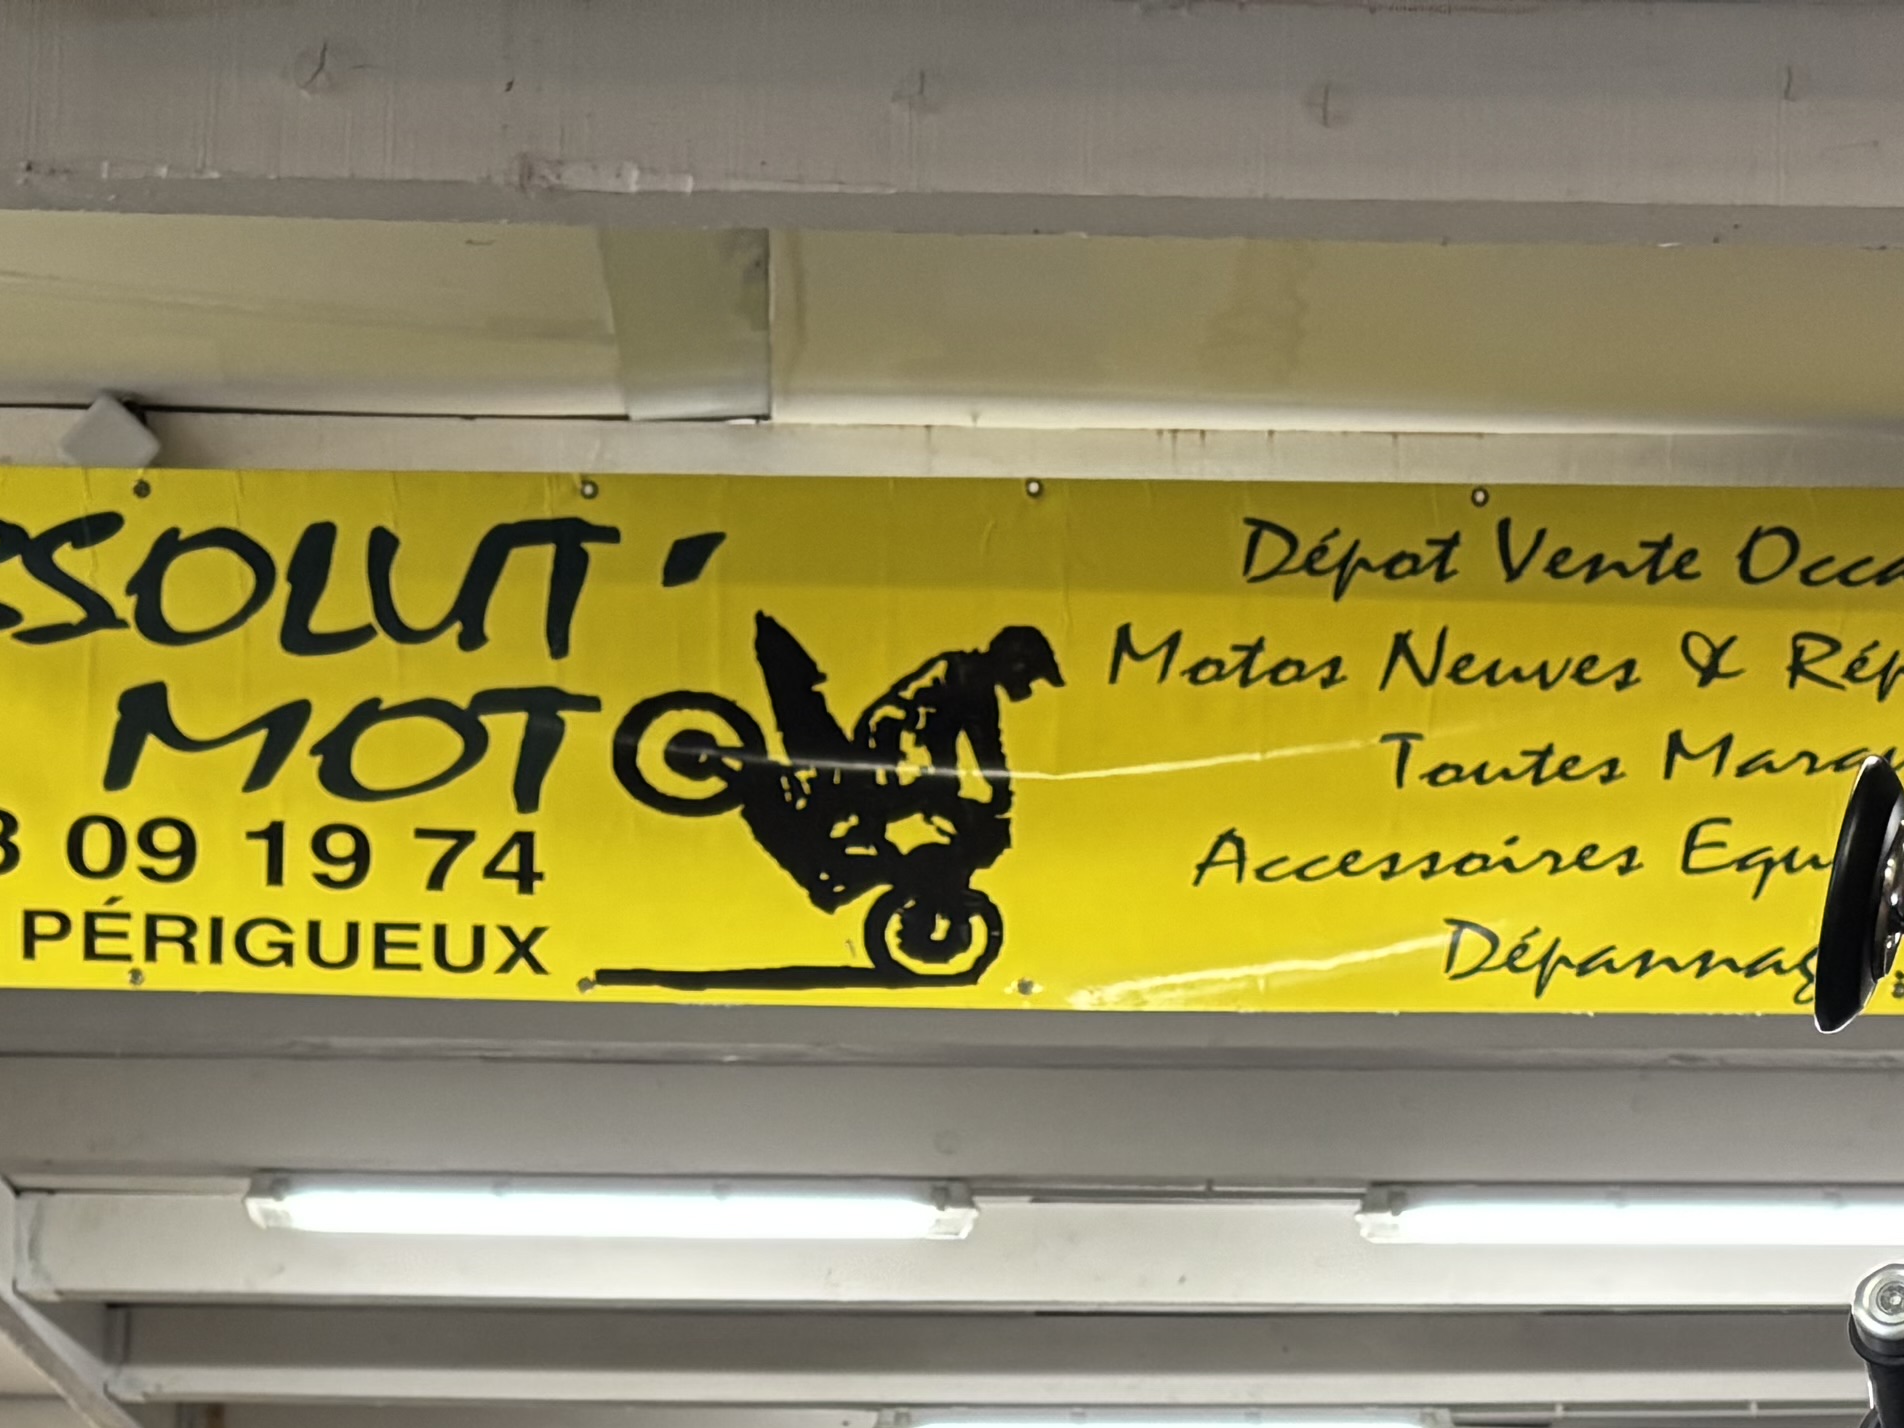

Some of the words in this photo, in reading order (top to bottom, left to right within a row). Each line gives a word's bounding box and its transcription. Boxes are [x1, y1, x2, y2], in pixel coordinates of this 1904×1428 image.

[1497, 518, 1702, 584] Vente
[1109, 624, 1347, 690] Motos
[1379, 627, 1641, 692] Neuves
[1681, 631, 1740, 689] &
[1380, 733, 1626, 789] Toutes
[66, 815, 197, 884] 09
[247, 822, 372, 890] 19
[413, 827, 545, 896] 74
[1193, 828, 1644, 887] Accessoires
[22, 897, 550, 977] PÉRIGUEUX
